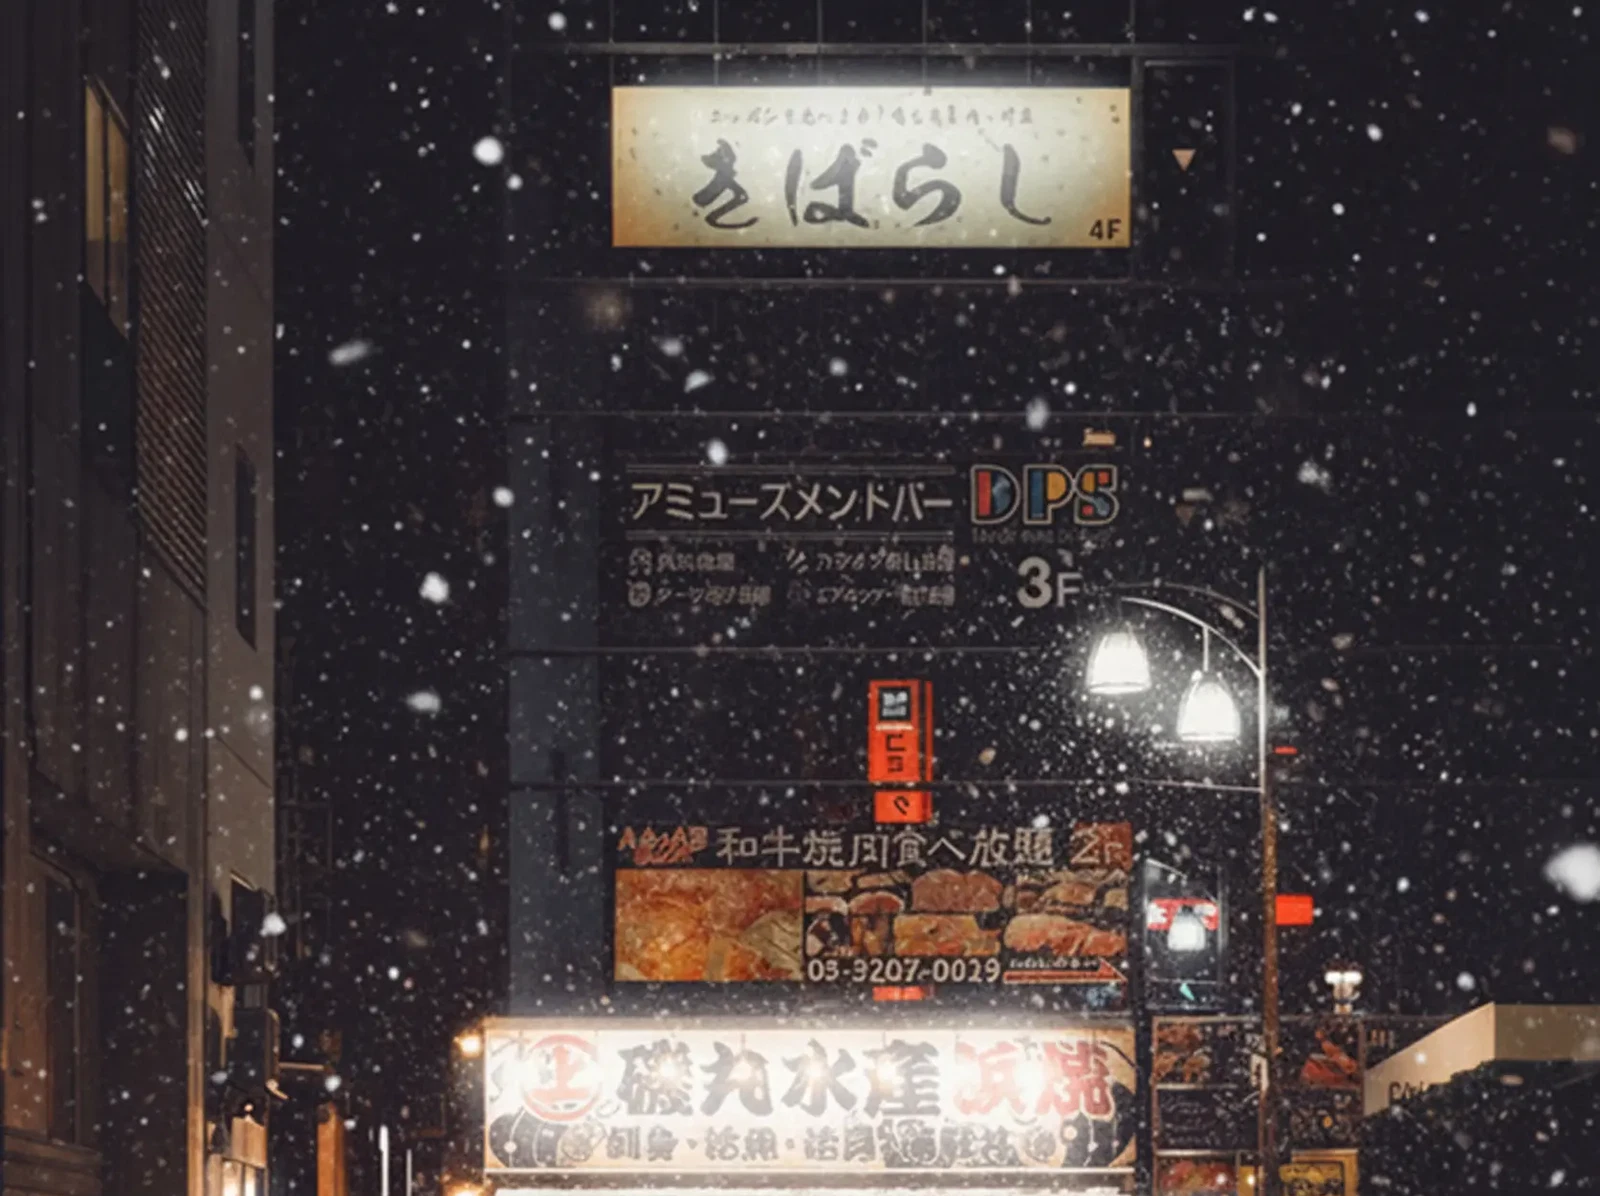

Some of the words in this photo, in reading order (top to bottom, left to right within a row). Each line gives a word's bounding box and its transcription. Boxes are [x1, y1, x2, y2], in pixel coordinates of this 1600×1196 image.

[692, 137, 1052, 229] きばらし
[1088, 218, 1122, 241] 4F
[970, 463, 1120, 526] DPS
[1017, 555, 1083, 609] 3F
